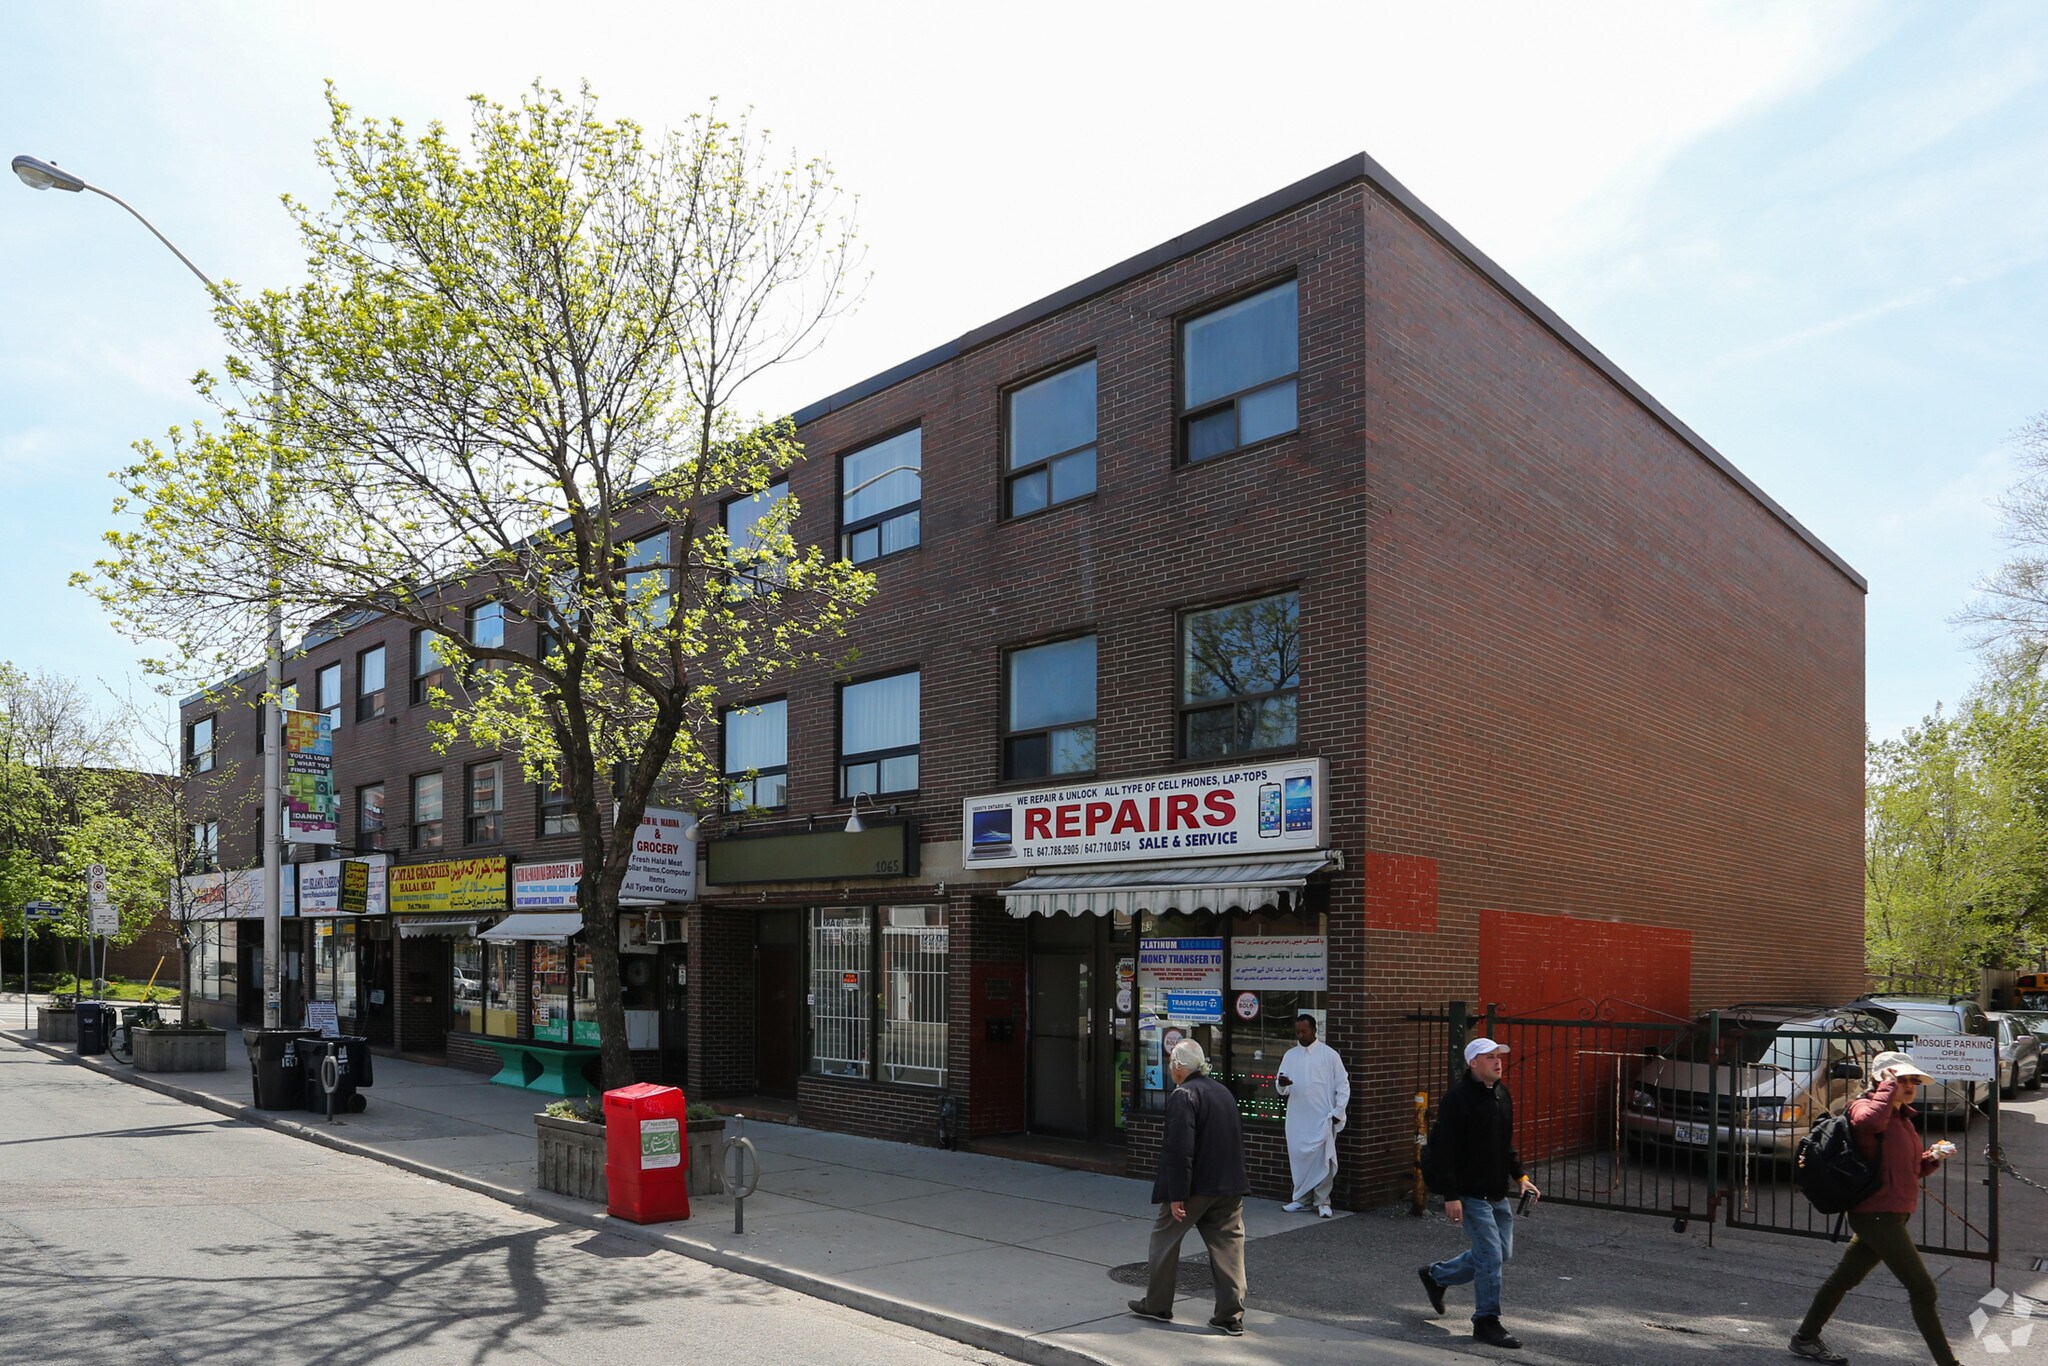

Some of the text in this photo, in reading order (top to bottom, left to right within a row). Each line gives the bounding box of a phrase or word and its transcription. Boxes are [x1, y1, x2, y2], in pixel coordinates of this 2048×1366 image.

[1017, 770, 1268, 805] WE REPAIR & UNLOCK ALL TYPE OF CELL PHONES, LAP-TOPS
[1025, 789, 1236, 840] REPAIRS
[652, 818, 657, 826] AL
[661, 818, 679, 828] MADINA
[655, 828, 661, 839] &
[1139, 831, 1238, 850] SALE & SERVICE
[637, 841, 678, 855] GROCERY
[1023, 848, 1034, 857] TEL
[1037, 845, 1079, 856] 647.786.2905
[1084, 841, 1130, 853] 647.710.0154
[632, 855, 650, 863] Fresh
[416, 865, 449, 879] GROCERIES
[546, 864, 569, 880] GROCERY
[570, 866, 574, 877] &
[875, 860, 899, 873] 1065
[400, 882, 436, 892] HALAL MEAT
[636, 883, 653, 891] Types
[664, 886, 687, 896] Grocery
[1140, 940, 1220, 949] PLATINUM EXCHANGE
[1141, 955, 1221, 964] MONEY TRANSFER TO
[587, 1030, 600, 1040] Hala
[1915, 1039, 1992, 1049] MOSQUE PARKING
